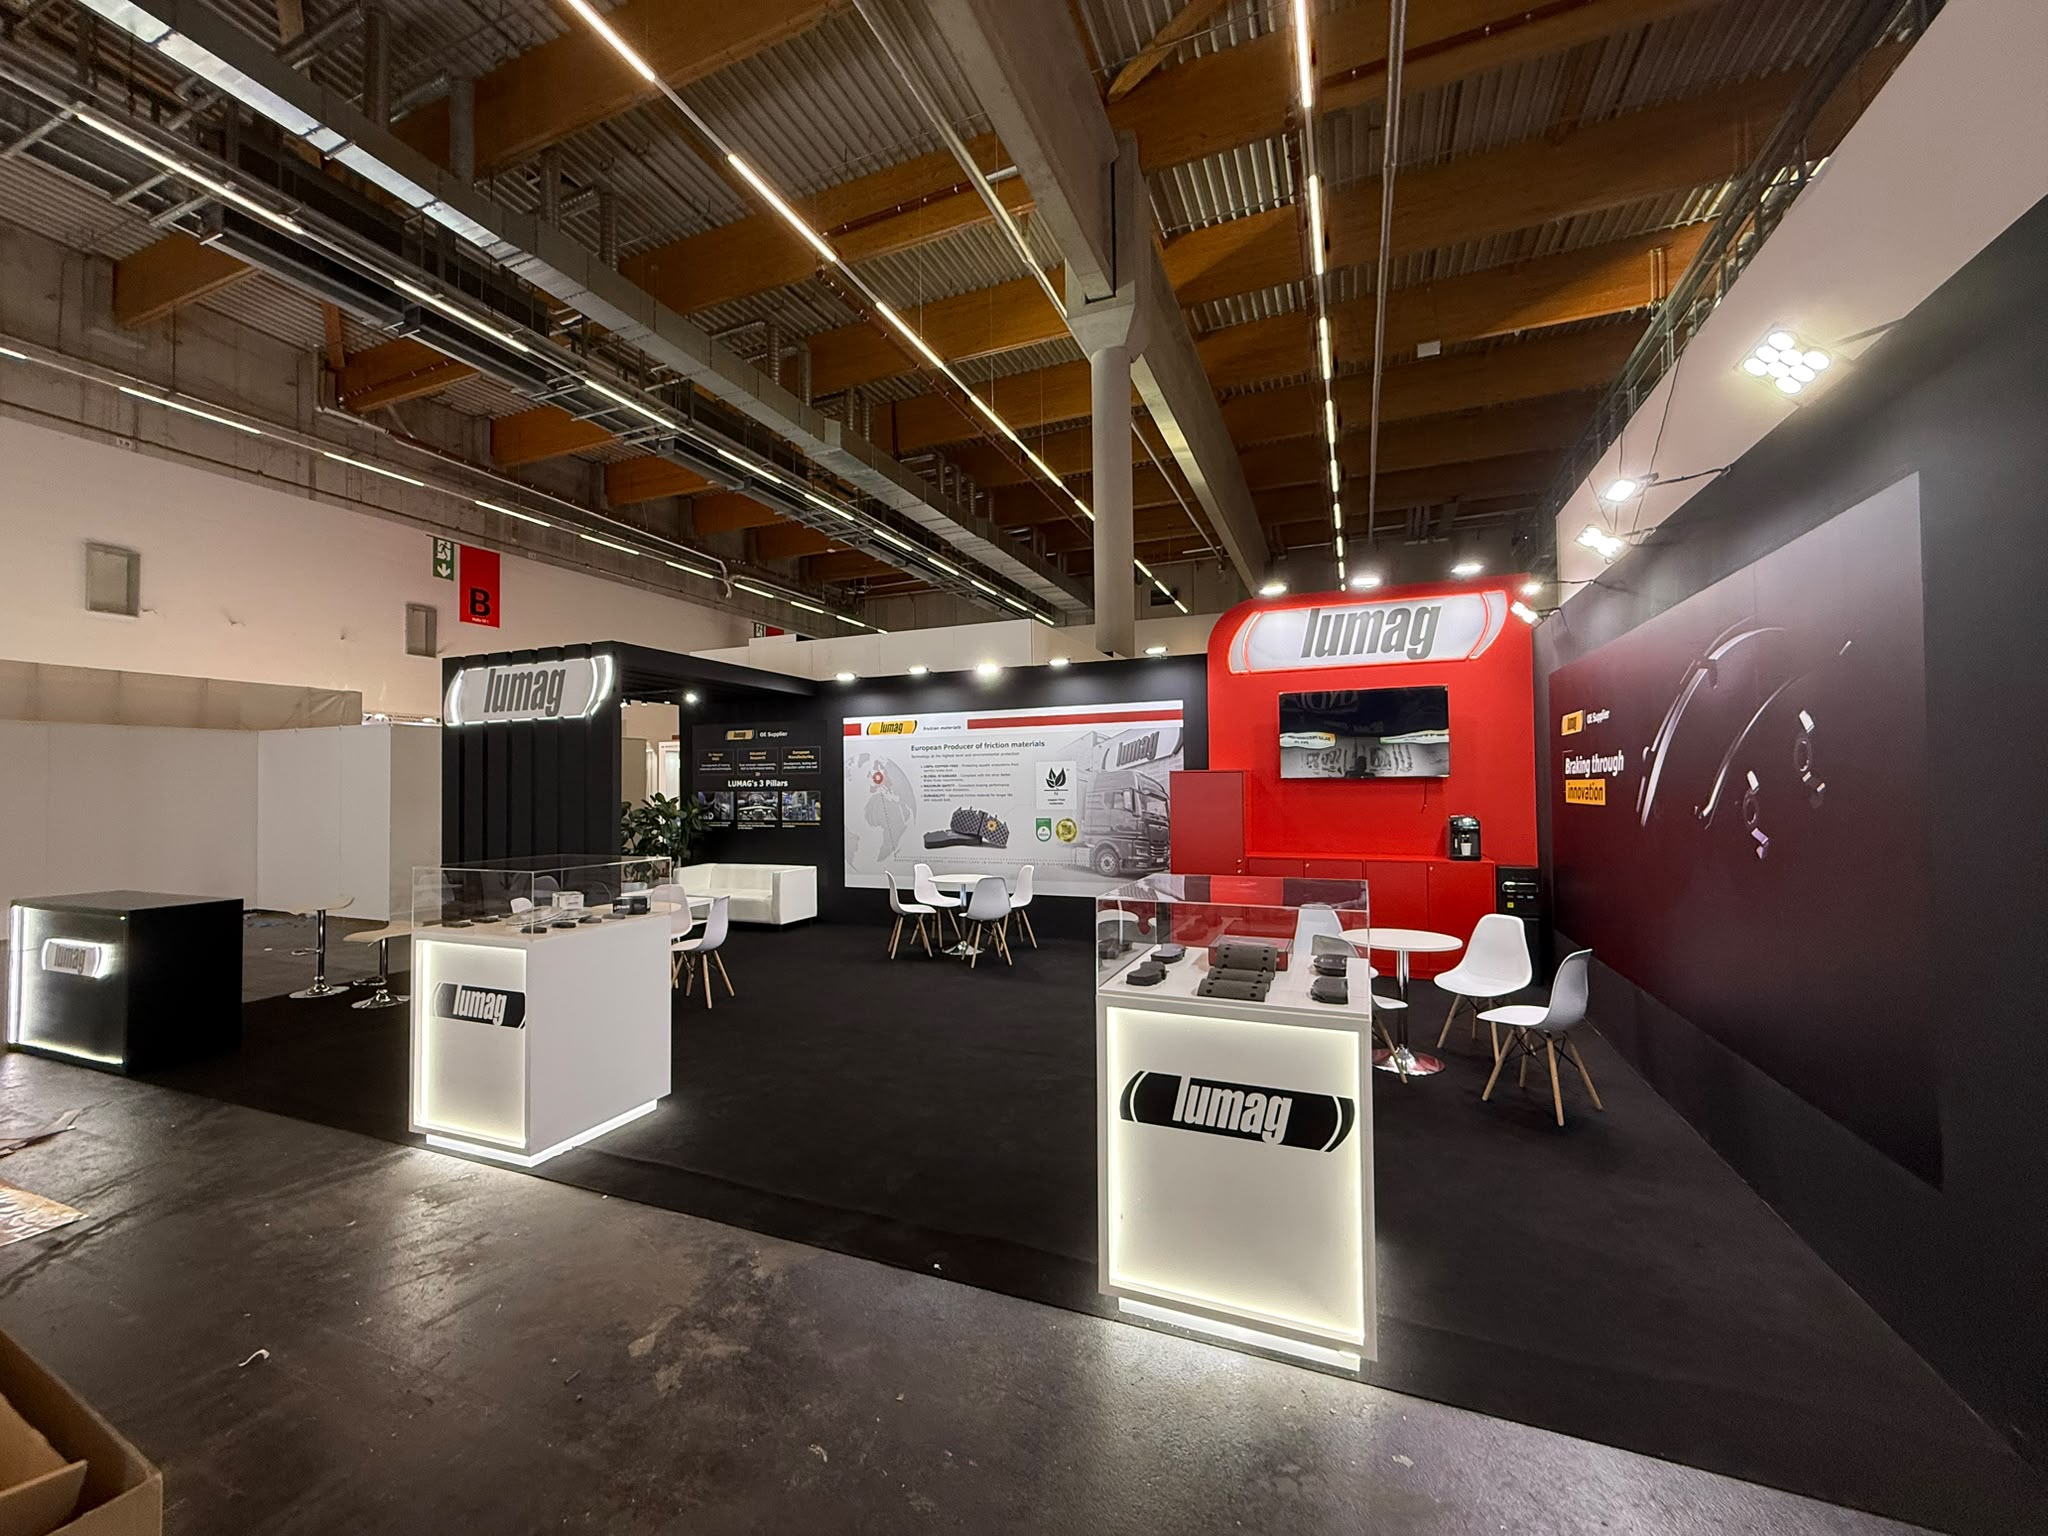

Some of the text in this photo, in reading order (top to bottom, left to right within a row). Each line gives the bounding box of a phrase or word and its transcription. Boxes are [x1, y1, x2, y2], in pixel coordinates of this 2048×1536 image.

[470, 587, 490, 617] B
[1301, 606, 1442, 660] lumag
[484, 668, 566, 717] lumag
[880, 722, 904, 734] lumag
[1592, 709, 1610, 724] Supplier
[768, 730, 788, 738] Supplier
[1011, 740, 1045, 748] materials
[1116, 731, 1160, 767] lumag
[1565, 750, 1624, 778] Braking through
[1568, 782, 1603, 801] innovation
[54, 944, 86, 975] lumag
[453, 984, 507, 1027] lumag
[1172, 1075, 1293, 1145] lumag
